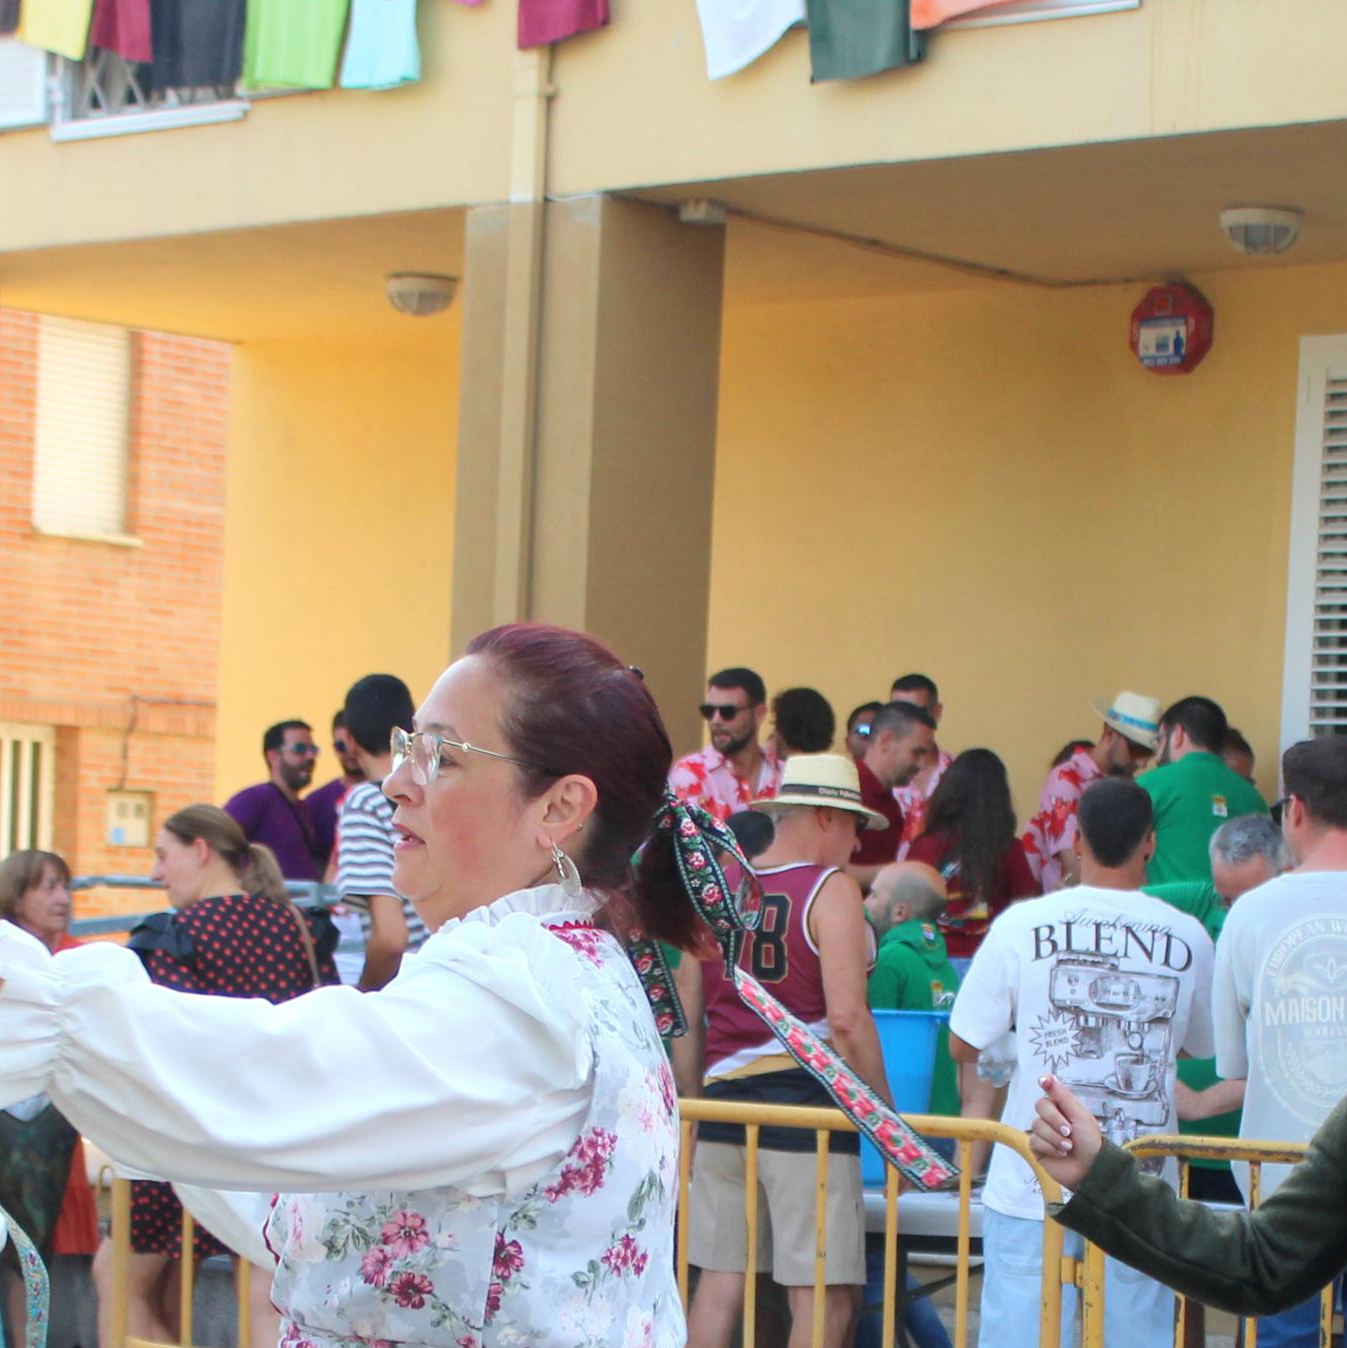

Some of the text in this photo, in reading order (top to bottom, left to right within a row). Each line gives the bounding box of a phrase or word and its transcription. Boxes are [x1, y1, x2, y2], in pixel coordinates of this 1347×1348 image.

[1031, 921, 1193, 972] BLEND
[1266, 919, 1326, 977] EUROPEAN
[1264, 996, 1345, 1027] MAISON
[1043, 1028, 1068, 1040] FRESH
[1045, 1036, 1070, 1048] BLEND
